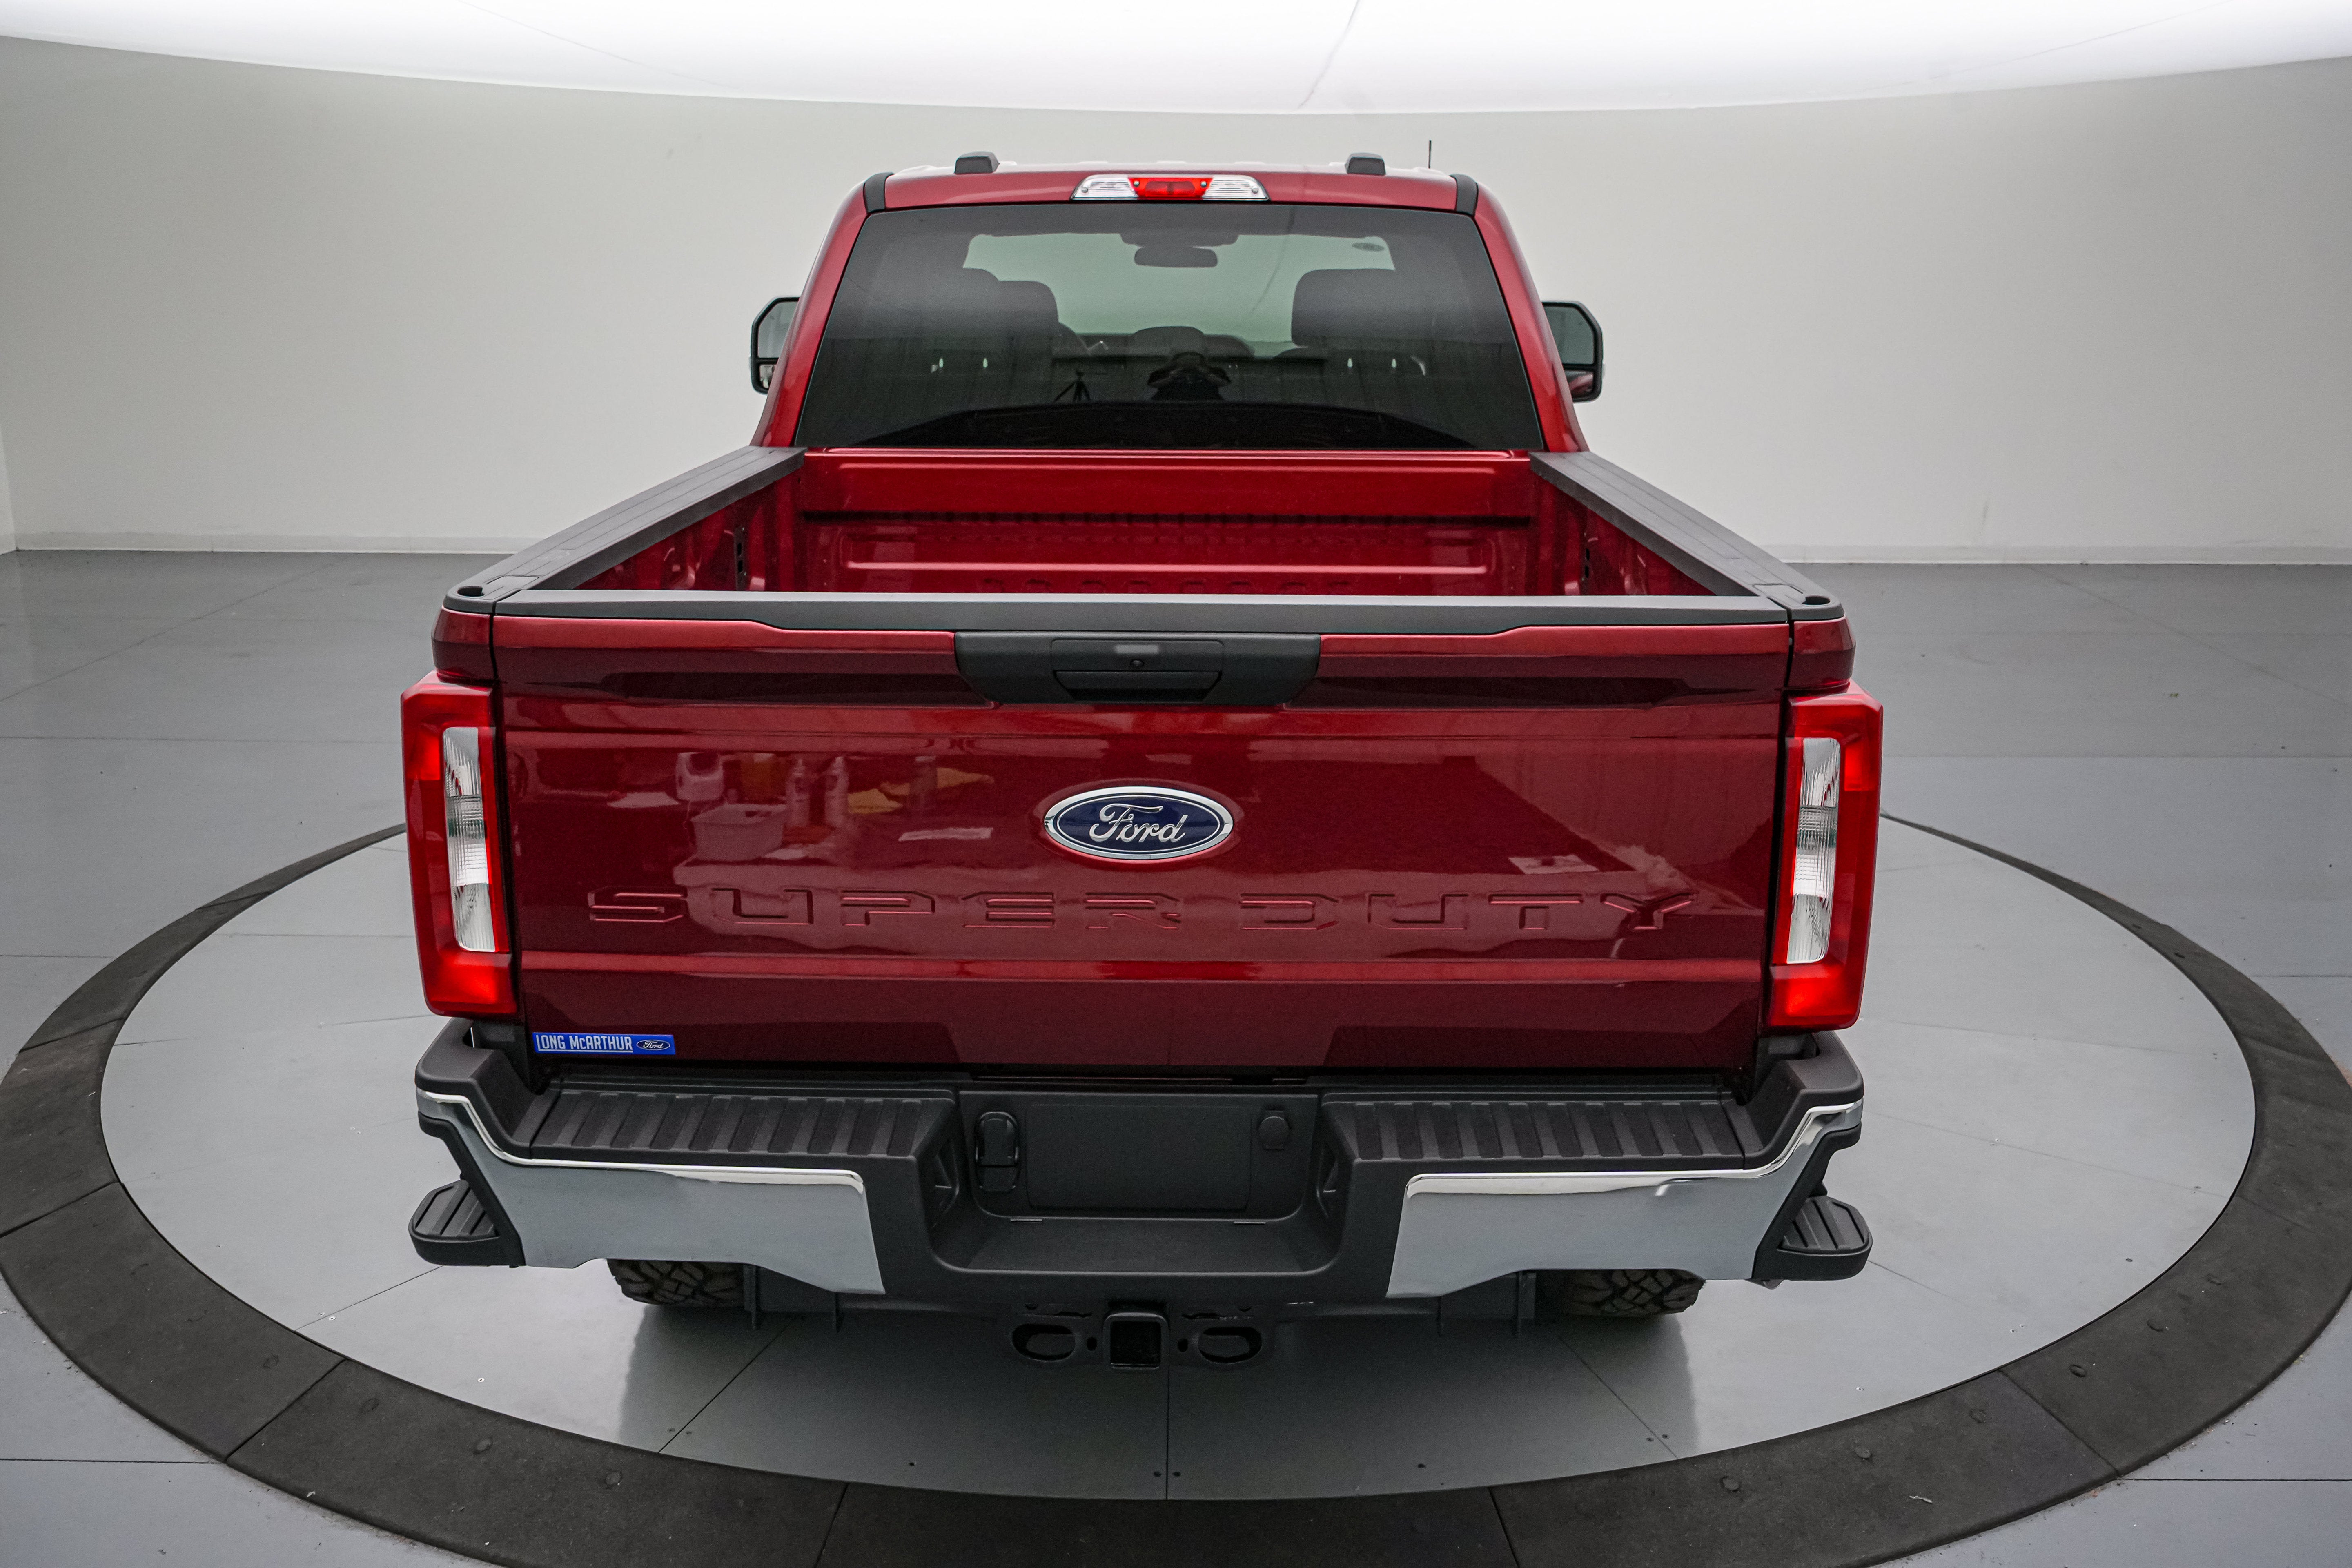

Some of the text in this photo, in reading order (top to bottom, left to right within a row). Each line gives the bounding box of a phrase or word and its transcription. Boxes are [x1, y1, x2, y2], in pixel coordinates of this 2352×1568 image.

[1089, 803, 1188, 842] Ford
[588, 886, 1697, 930] SUPER DUTY
[536, 1034, 664, 1051] LONG McARTHUR Ford
